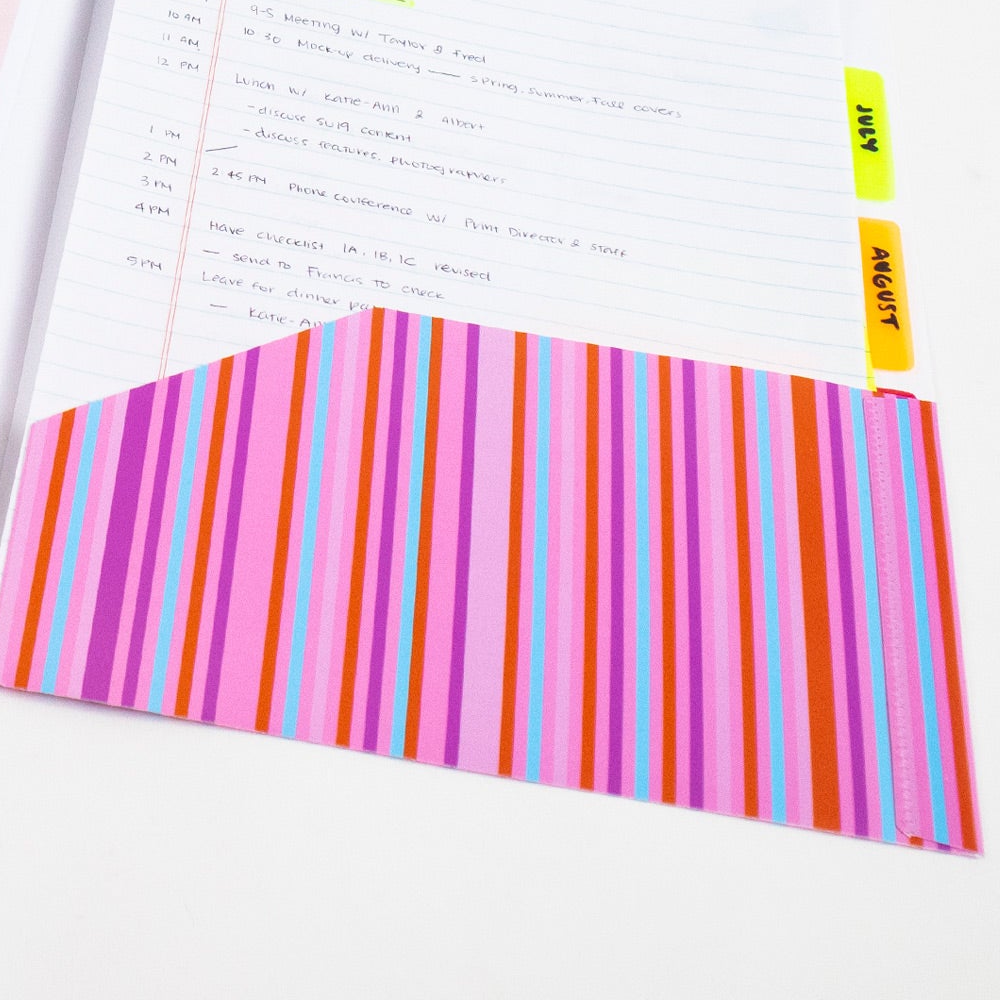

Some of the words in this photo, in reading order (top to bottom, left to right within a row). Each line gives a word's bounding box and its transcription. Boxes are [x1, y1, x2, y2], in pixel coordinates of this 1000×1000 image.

[168, 10, 180, 20] 10
[184, 13, 202, 24] AM
[284, 13, 341, 35] Meeting
[157, 56, 169, 67] 12
[180, 61, 200, 72] PM
[165, 130, 181, 140] PM
[856, 104, 879, 152] JULY
[143, 152, 153, 162] 2
[159, 155, 178, 167] PM
[141, 176, 150, 186] 3
[154, 180, 172, 192] PM
[248, 174, 267, 185] PM
[135, 202, 145, 212] 4
[149, 204, 170, 216] PM
[209, 221, 245, 236] Have
[435, 262, 492, 282] revised
[141, 259, 162, 271] PM
[202, 271, 244, 287] Leave
[871, 246, 900, 331] AUGUST
